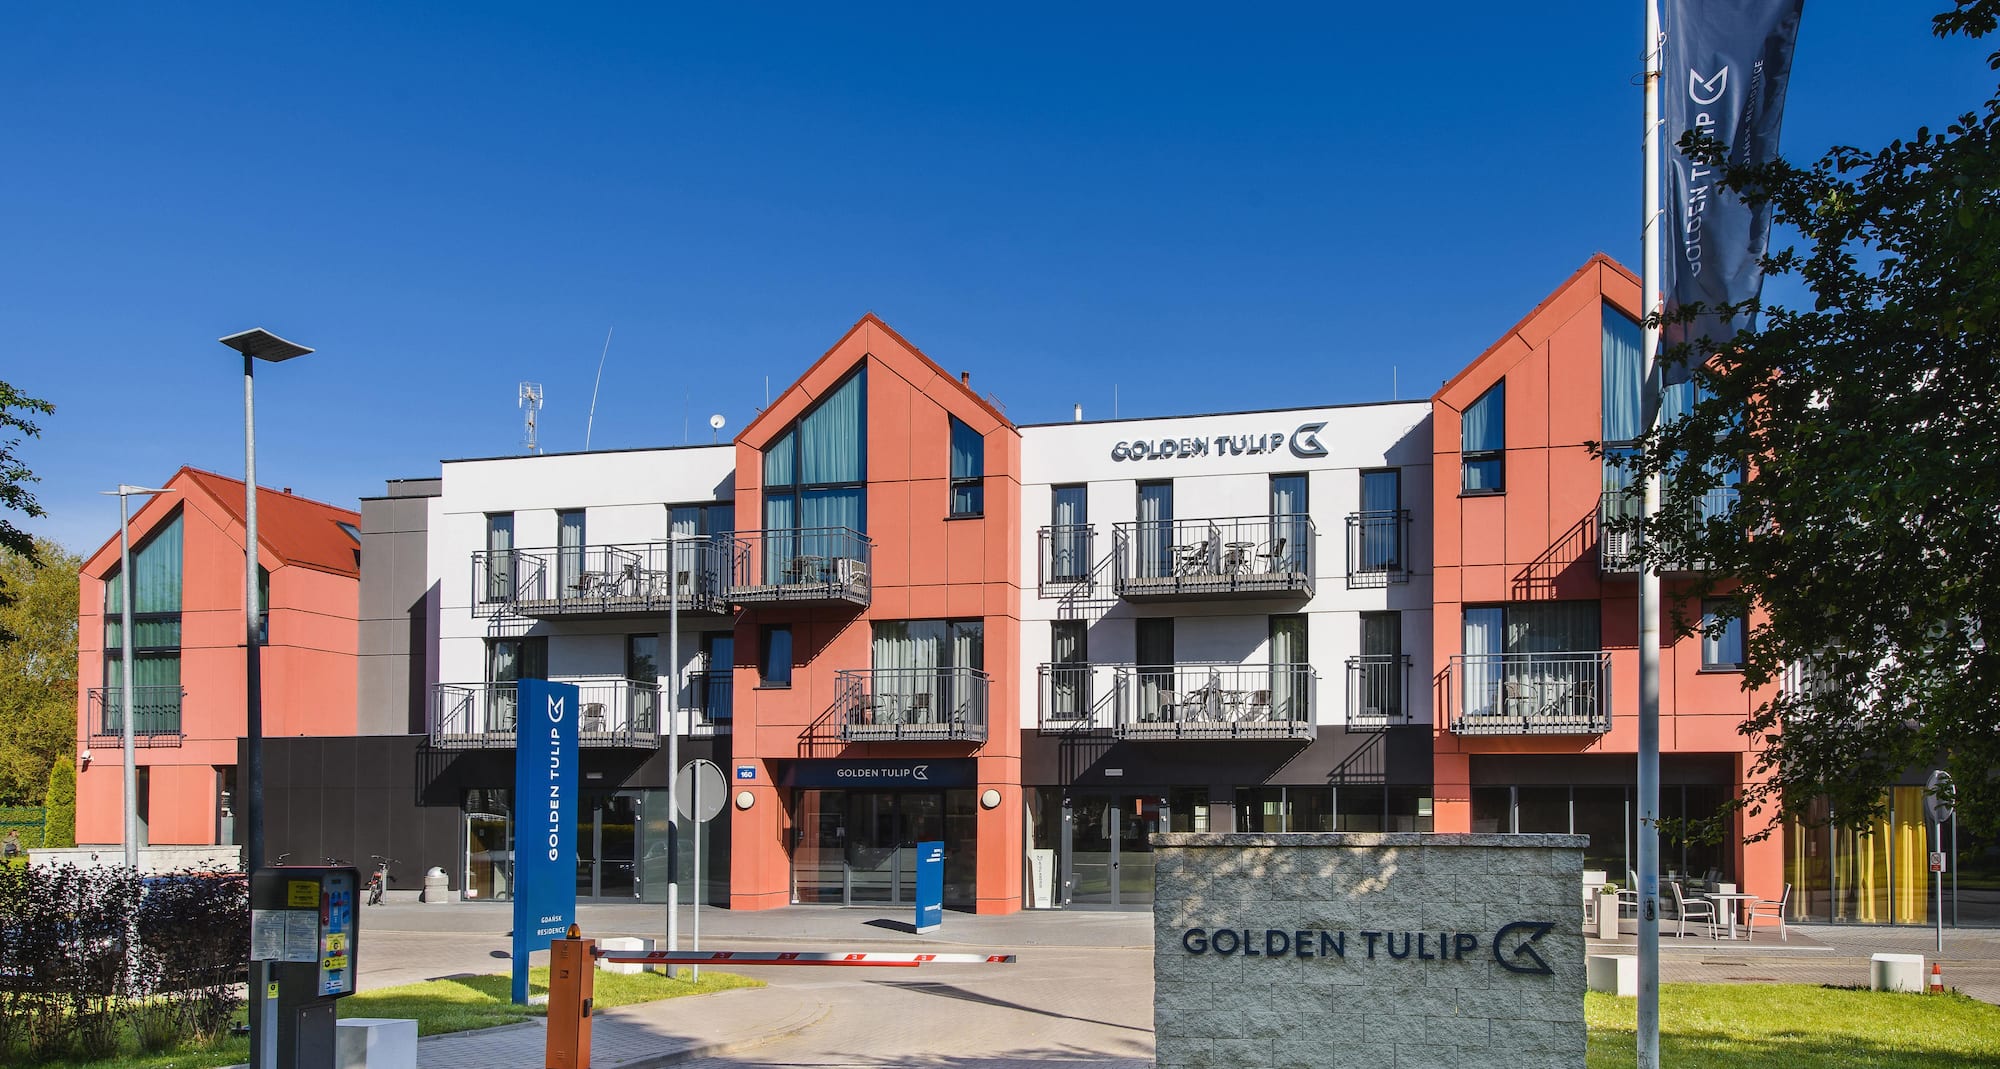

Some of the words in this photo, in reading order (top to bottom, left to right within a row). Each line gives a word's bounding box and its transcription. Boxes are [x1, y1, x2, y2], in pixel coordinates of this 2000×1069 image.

[1112, 436, 1209, 461] GOLDEN
[1216, 432, 1285, 456] TULIP
[550, 727, 560, 780] TULIP
[837, 768, 879, 778] GOLDEN
[881, 768, 911, 778] TULIP
[549, 785, 560, 862] GOLDEN
[537, 926, 565, 936] RESIDENCE
[1182, 928, 1345, 958] GOLDEN
[1360, 931, 1478, 960] TULIP
